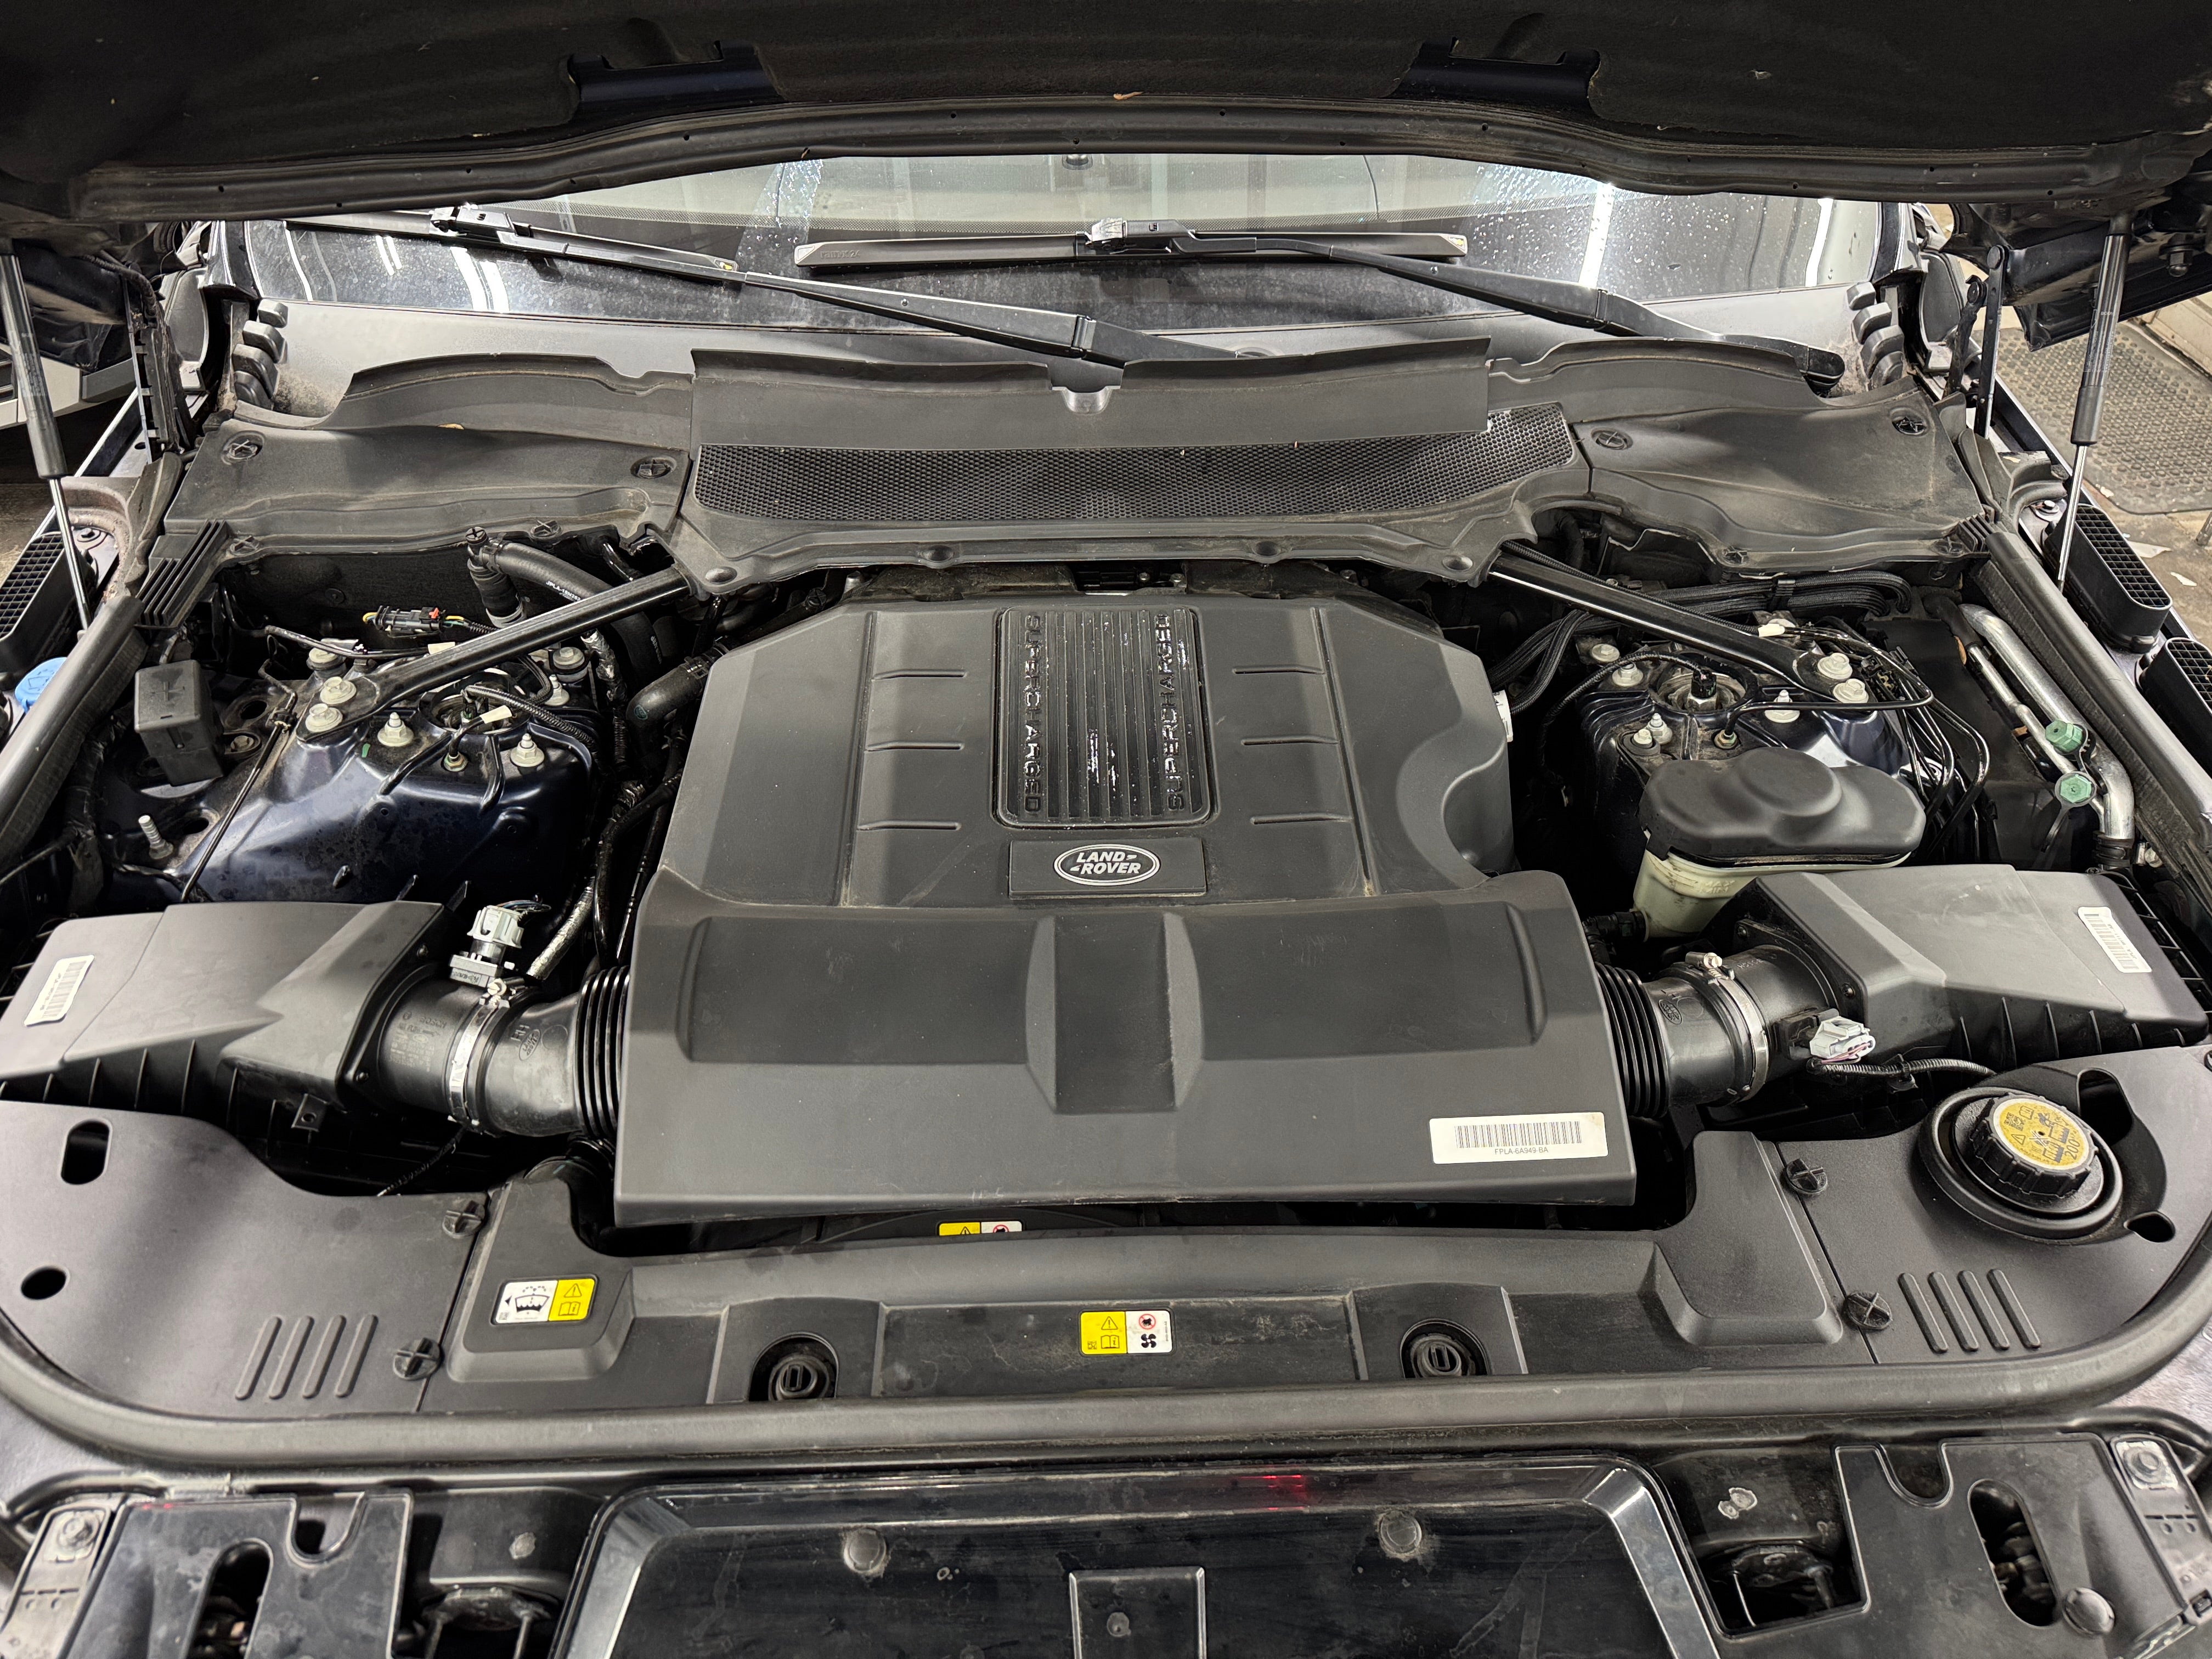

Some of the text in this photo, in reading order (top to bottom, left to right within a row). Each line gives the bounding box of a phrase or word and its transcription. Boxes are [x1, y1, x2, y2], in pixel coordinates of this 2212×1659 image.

[1024, 614, 1042, 814] SUPERCHARGED
[1154, 614, 1185, 811] SUPERCHARGED
[1076, 851, 1125, 863] LAND
[1081, 862, 1141, 874] ROVER
[1494, 1147, 1549, 1155] FPLA-6A949-BA
[2064, 1139, 2080, 1160] 200
